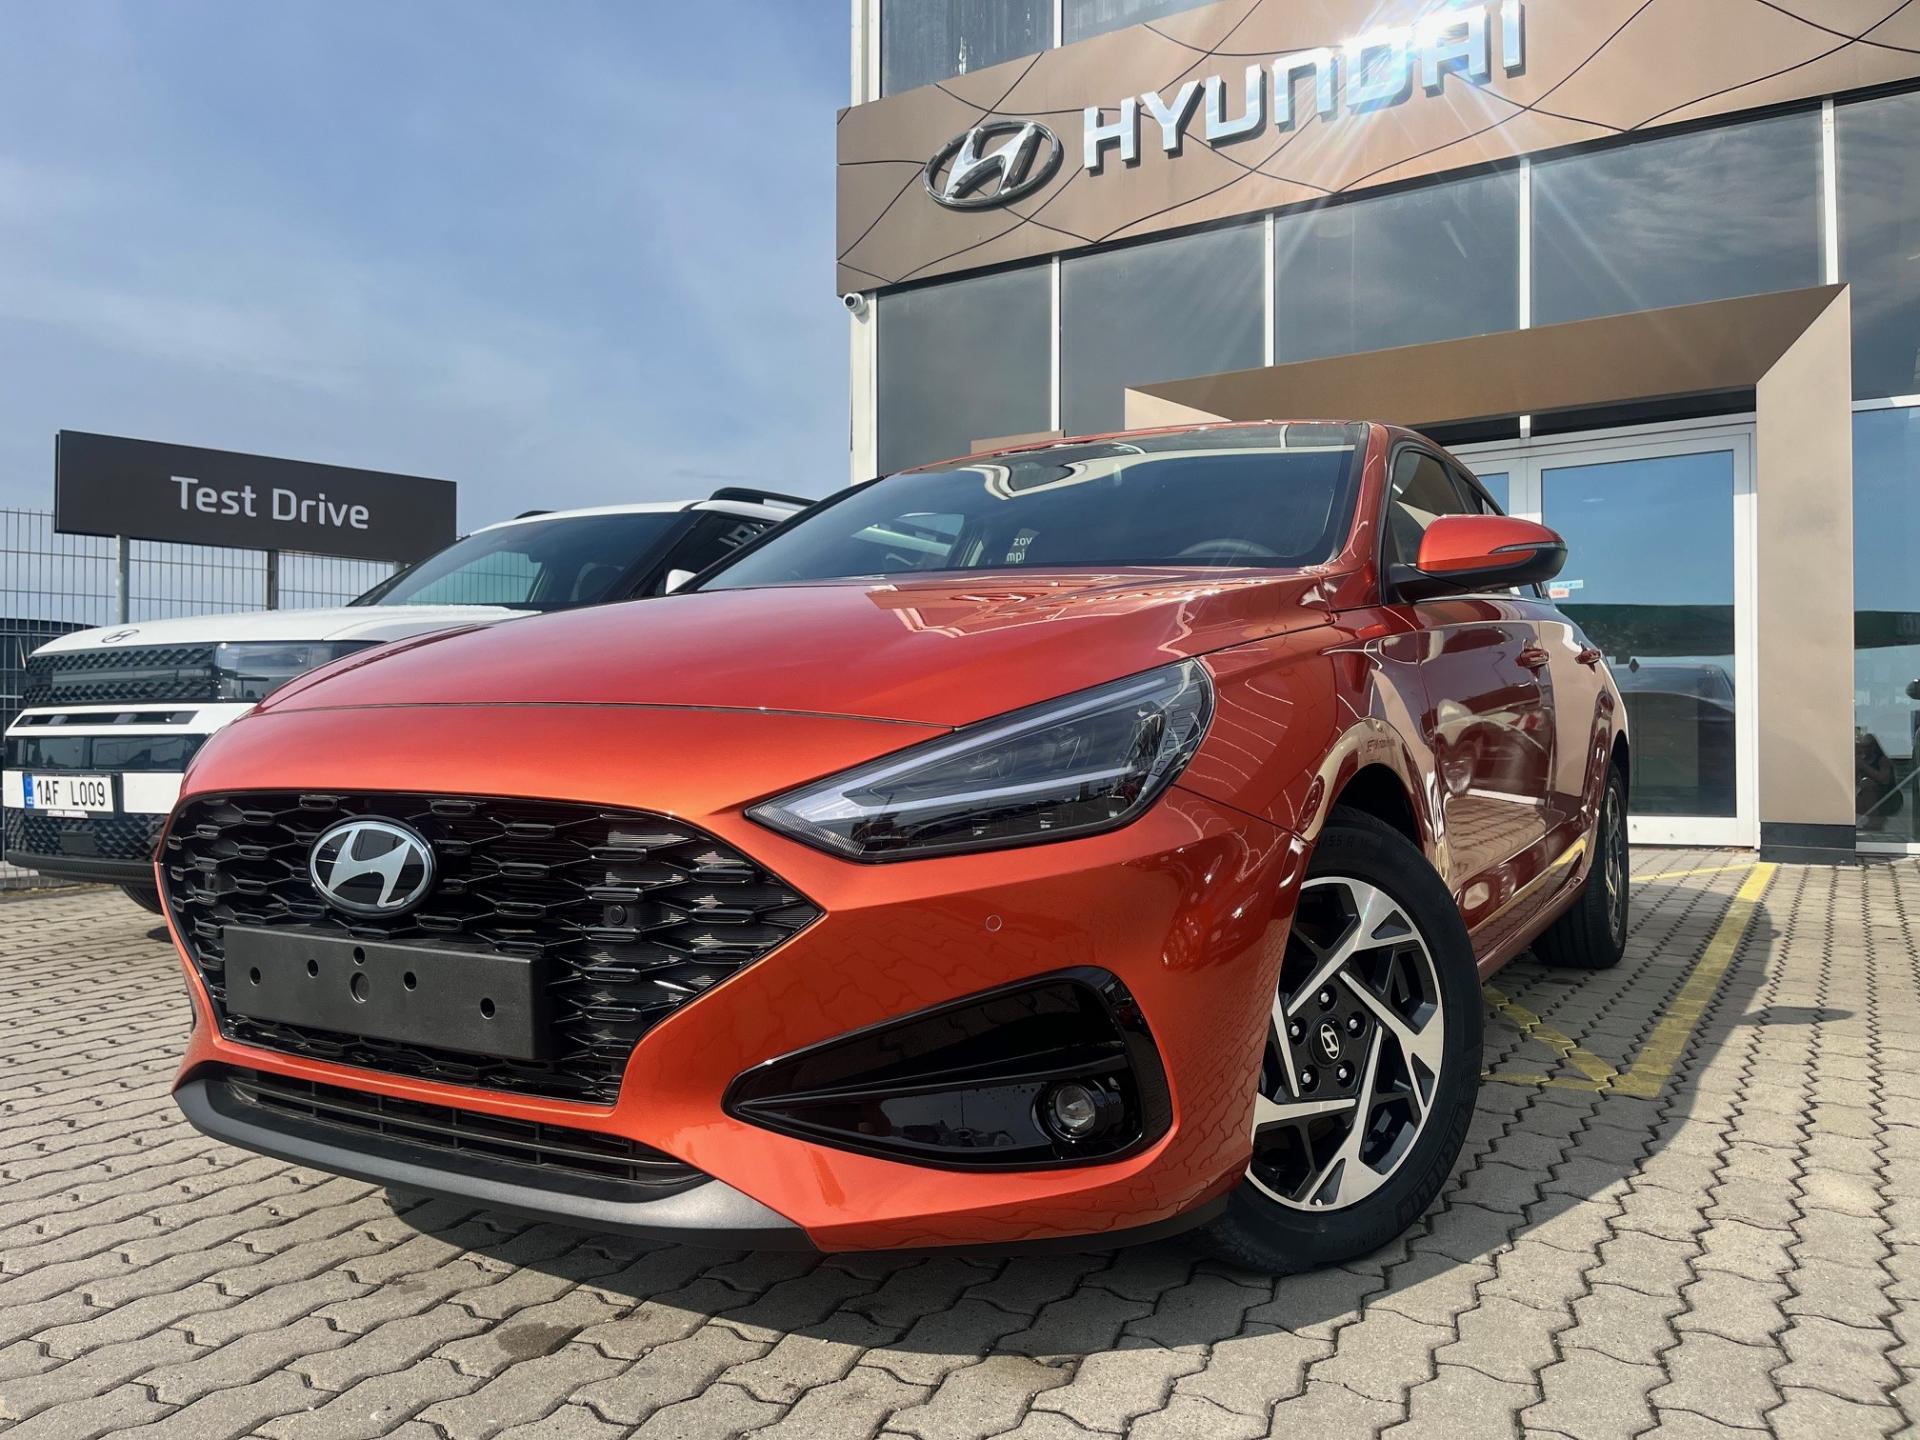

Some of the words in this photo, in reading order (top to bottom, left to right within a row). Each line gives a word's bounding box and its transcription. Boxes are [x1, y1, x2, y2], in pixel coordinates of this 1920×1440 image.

[1083, 0, 1525, 172] HYUNDAI
[170, 475, 257, 518] Test
[272, 487, 370, 530] Drive
[1013, 537, 1033, 546] zov
[1006, 549, 1025, 563] mpi
[36, 780, 59, 805] 1AF
[70, 781, 106, 807] L009
